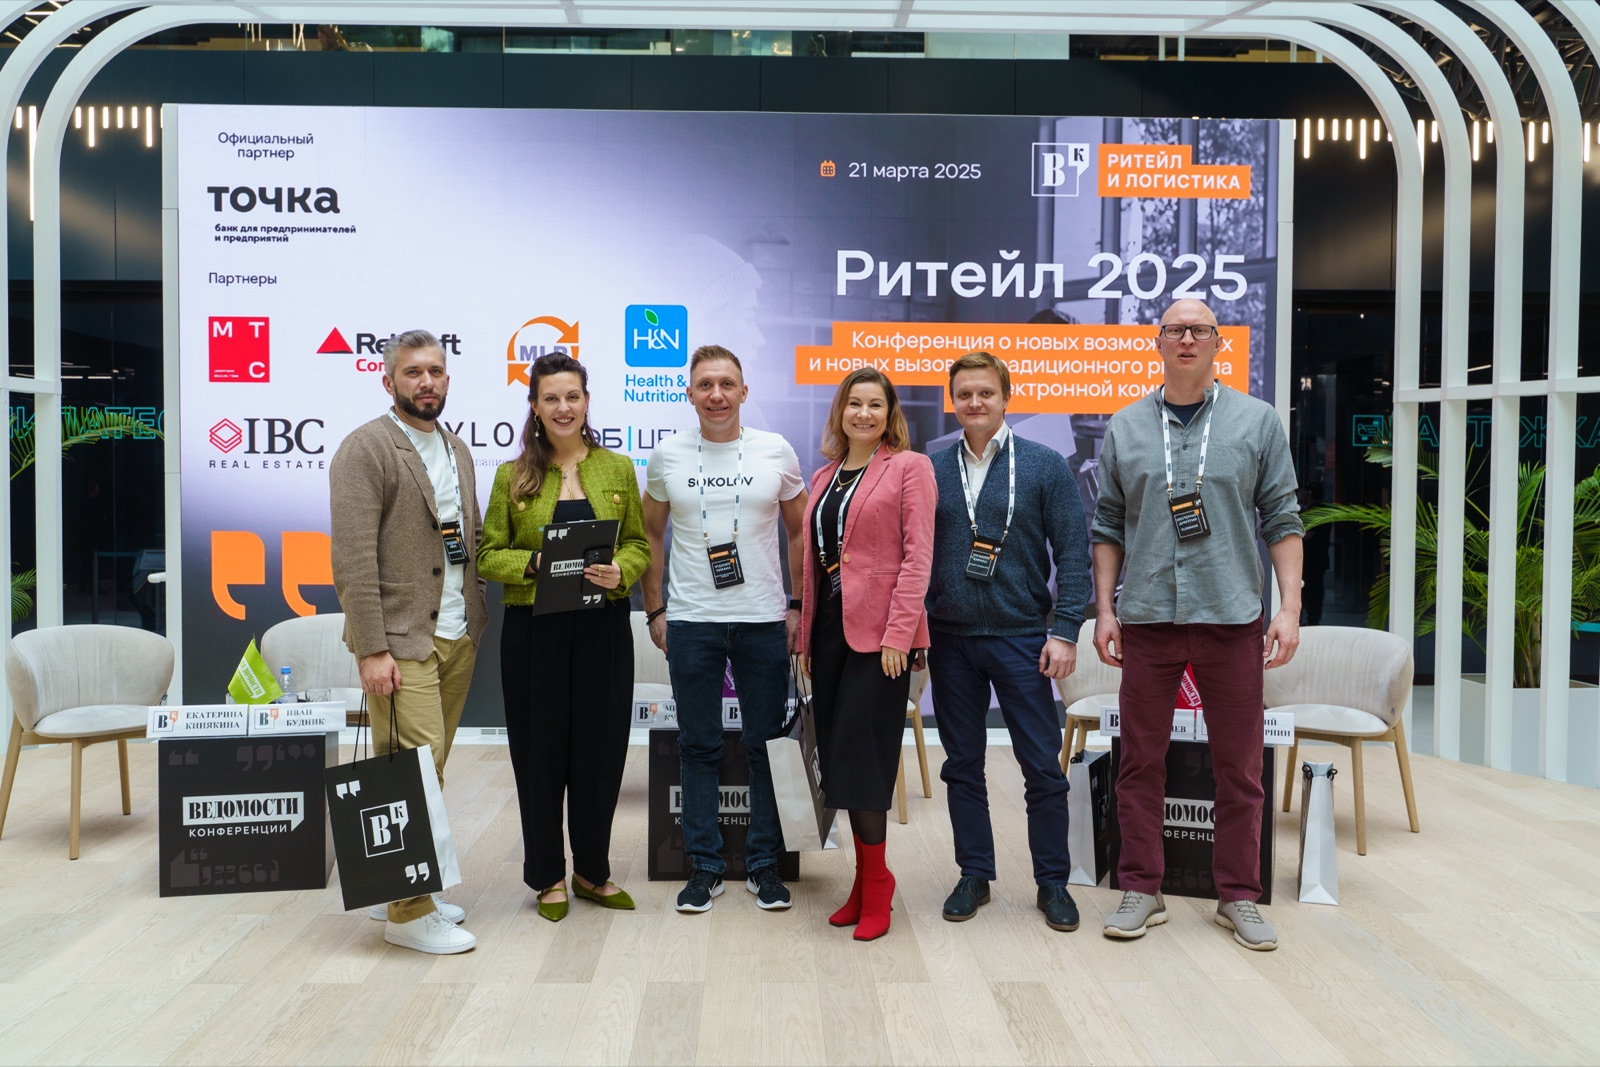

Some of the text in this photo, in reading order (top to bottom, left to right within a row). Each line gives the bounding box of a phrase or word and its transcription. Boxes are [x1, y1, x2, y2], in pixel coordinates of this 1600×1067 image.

[218, 132, 314, 146] Официальный
[237, 148, 295, 161] партнер
[1107, 150, 1182, 169] РИТЕЙЛ
[848, 161, 982, 182] 21 марта 2025
[1107, 174, 1241, 190] И ЛОГИСТИКА
[214, 223, 357, 235] банк для предпринимателей
[223, 234, 289, 244] предприятий
[208, 272, 278, 287] Партнеры
[836, 249, 1248, 300] Ритейл 2025
[633, 328, 679, 350] H&N
[852, 331, 994, 353] Конференция
[998, 336, 1011, 350] о
[1016, 337, 1079, 350] новых
[809, 358, 821, 371] и
[826, 358, 890, 371] новых
[895, 358, 954, 372] вызов
[1003, 358, 1143, 375] адиционного
[625, 374, 687, 387] Health &
[624, 389, 687, 402] Nutrition
[243, 418, 324, 454] IBC
[209, 460, 325, 469] REAL ESTATE
[688, 476, 753, 488] SOKOLOV
[186, 711, 243, 719] ЕКАТЕРИНА
[185, 722, 240, 730] КИНЯКИНА
[286, 718, 325, 727] БУДНИК
[188, 797, 299, 821] ВЕДОМОСТИ
[189, 824, 287, 837] КОНФЕРЕНЦИИ
